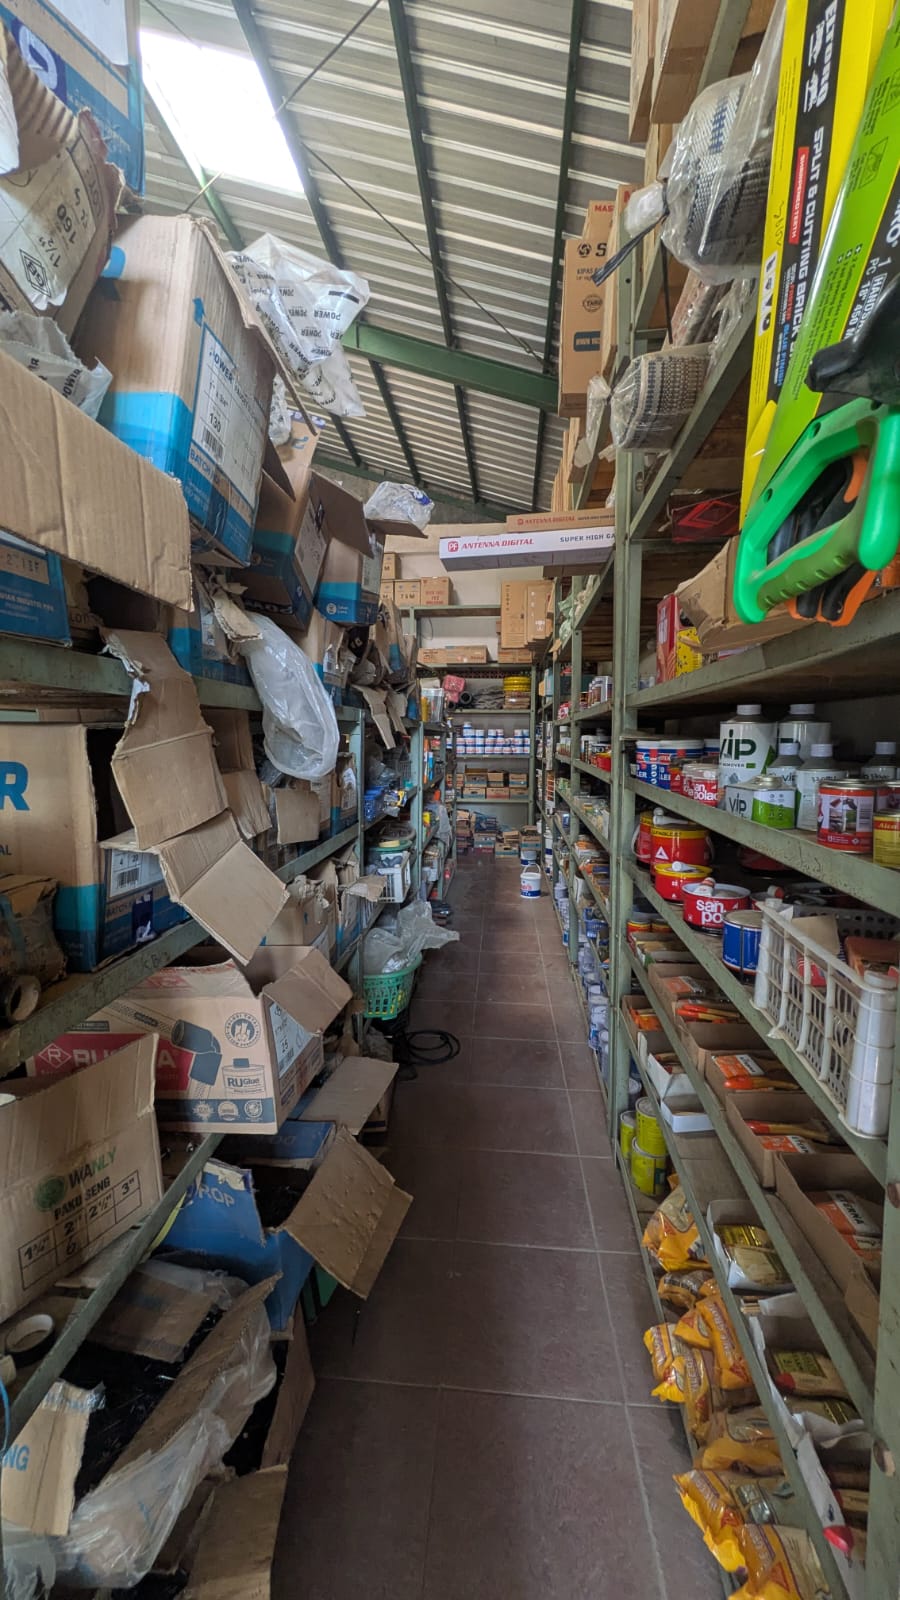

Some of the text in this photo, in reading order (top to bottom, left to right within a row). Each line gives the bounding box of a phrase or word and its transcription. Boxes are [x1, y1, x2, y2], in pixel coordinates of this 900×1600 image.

[810, 126, 824, 181] SPLIT
[56, 204, 77, 244] 160
[799, 200, 816, 279] CUTTING
[864, 257, 880, 276] PC
[314, 310, 341, 321] POWER
[461, 541, 500, 551] ANTENNA
[501, 538, 534, 548] DIGITAL
[729, 793, 747, 815] VIP
[68, 1147, 117, 1188] WANLY
[86, 1177, 111, 1200] SENG
